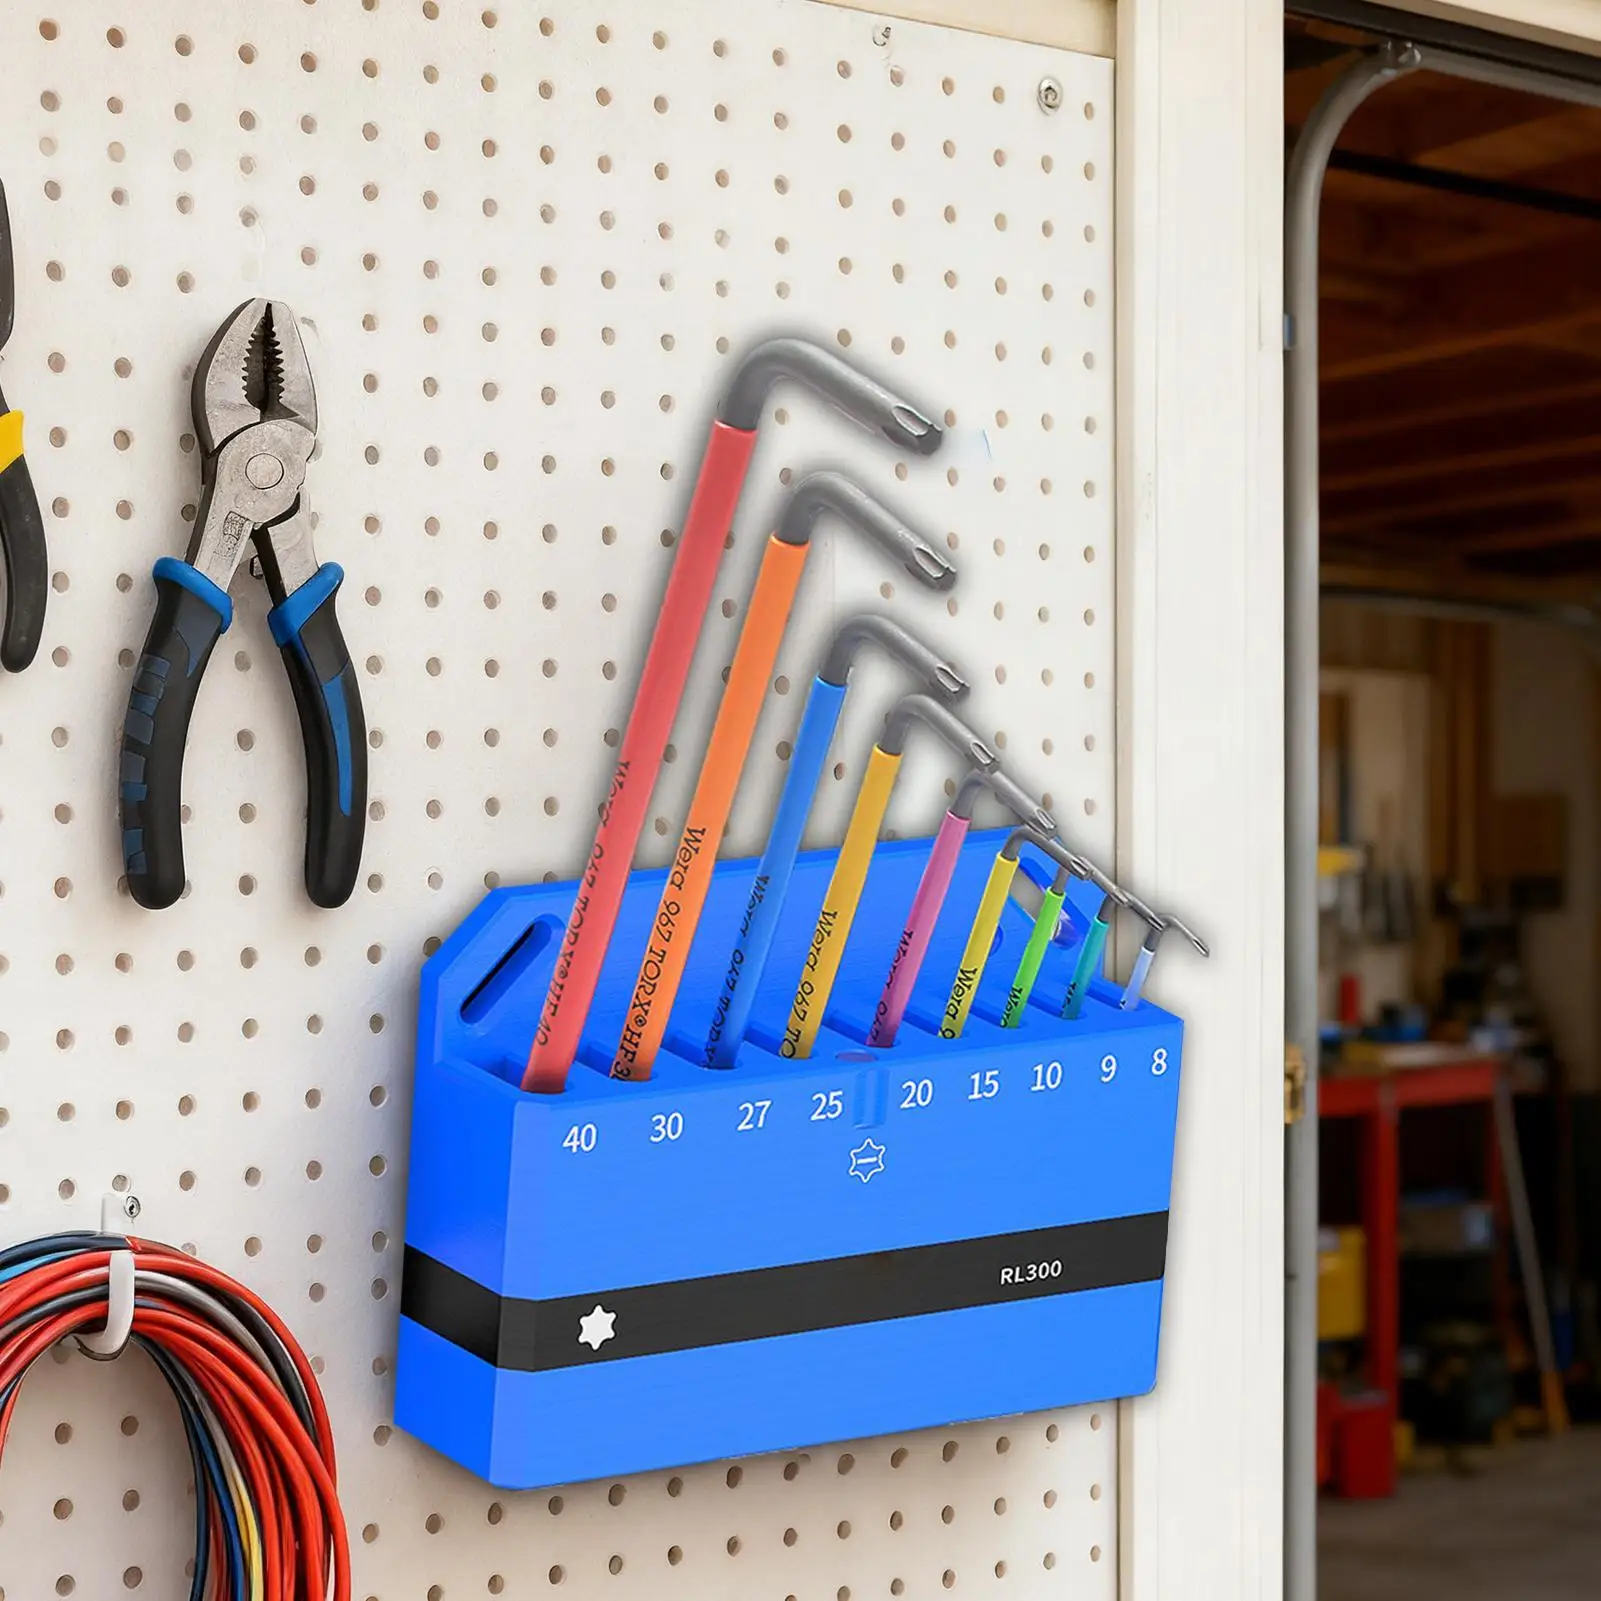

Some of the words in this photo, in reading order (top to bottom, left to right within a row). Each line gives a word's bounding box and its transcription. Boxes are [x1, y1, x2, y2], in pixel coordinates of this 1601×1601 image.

[670, 827, 706, 890] Wera
[656, 900, 680, 943] 967
[806, 910, 837, 972] Wera
[945, 967, 978, 1020] Wera
[562, 1123, 597, 1153] 40
[650, 1112, 683, 1142] 30
[737, 1100, 771, 1131] 27
[810, 1090, 843, 1121] 25
[900, 1079, 933, 1109] 20
[968, 1070, 999, 1100] 15
[1031, 1062, 1062, 1091] 10
[1101, 1055, 1117, 1082] 9
[1151, 1048, 1167, 1075] 8
[1000, 1260, 1062, 1285] RL300
